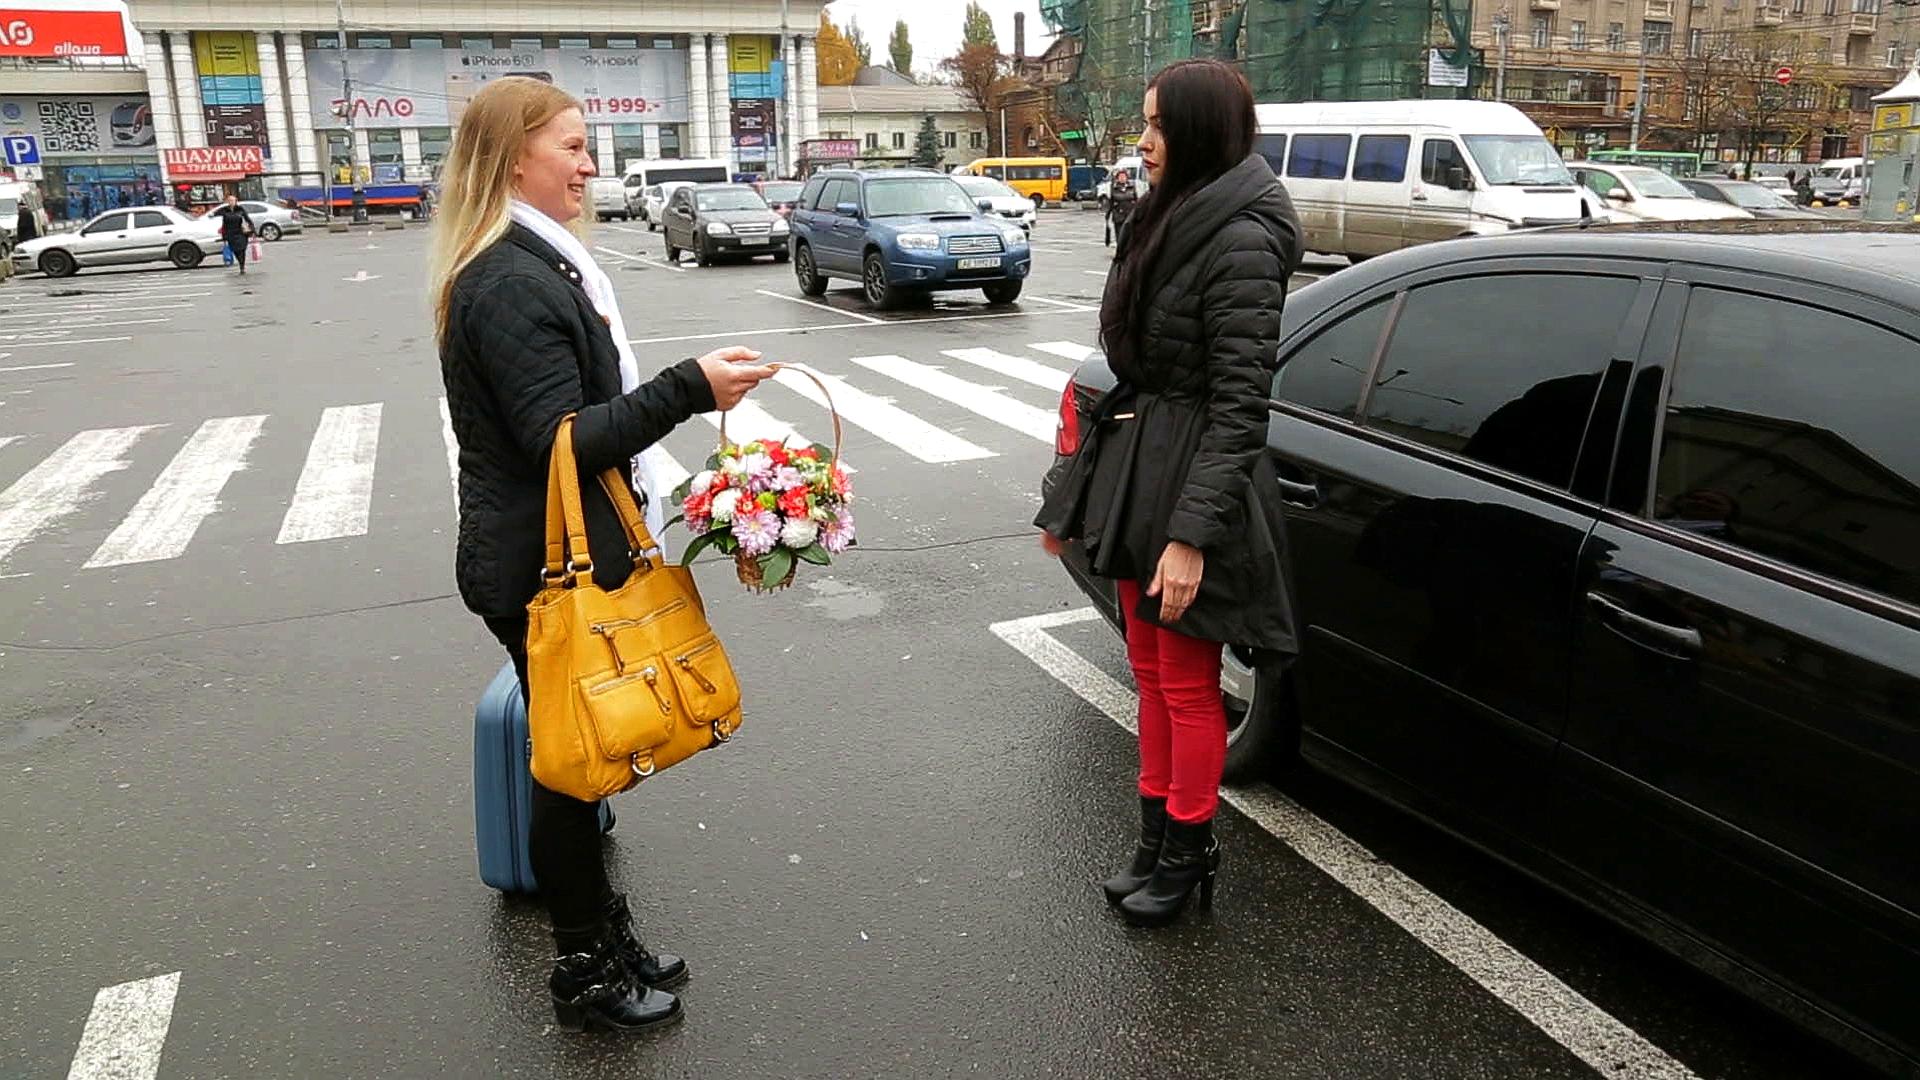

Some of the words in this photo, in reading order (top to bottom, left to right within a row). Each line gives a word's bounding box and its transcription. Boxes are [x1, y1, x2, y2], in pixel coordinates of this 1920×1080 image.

[54, 41, 102, 55] alla.ua
[471, 55, 511, 66] iPhone
[585, 98, 601, 113] 11
[11, 139, 31, 163] P
[167, 148, 259, 164] ШАУРМА
